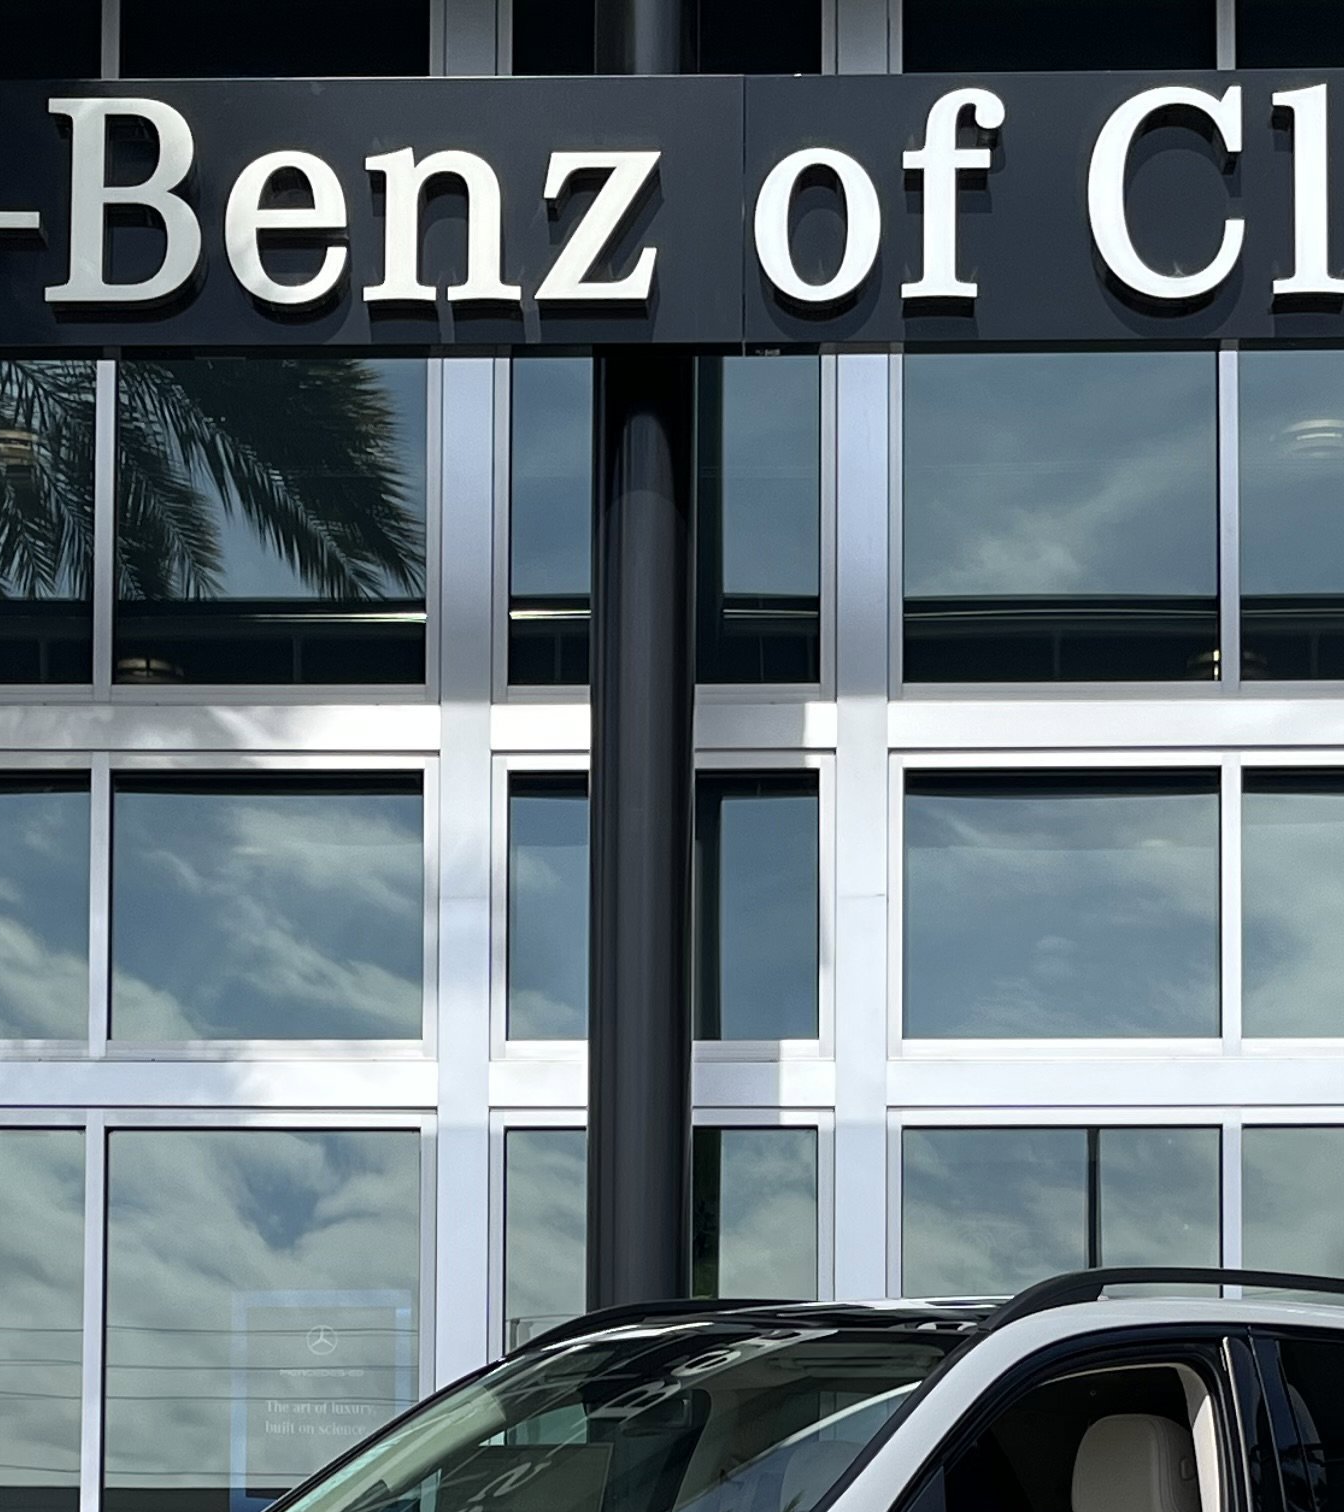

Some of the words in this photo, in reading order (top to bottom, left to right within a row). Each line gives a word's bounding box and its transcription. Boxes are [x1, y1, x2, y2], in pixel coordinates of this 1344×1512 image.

[752, 87, 1007, 304] of
[265, 1400, 289, 1413] The
[293, 1401, 311, 1413] art
[315, 1401, 329, 1414] of
[265, 1420, 295, 1434] built
[298, 1424, 315, 1434] on
